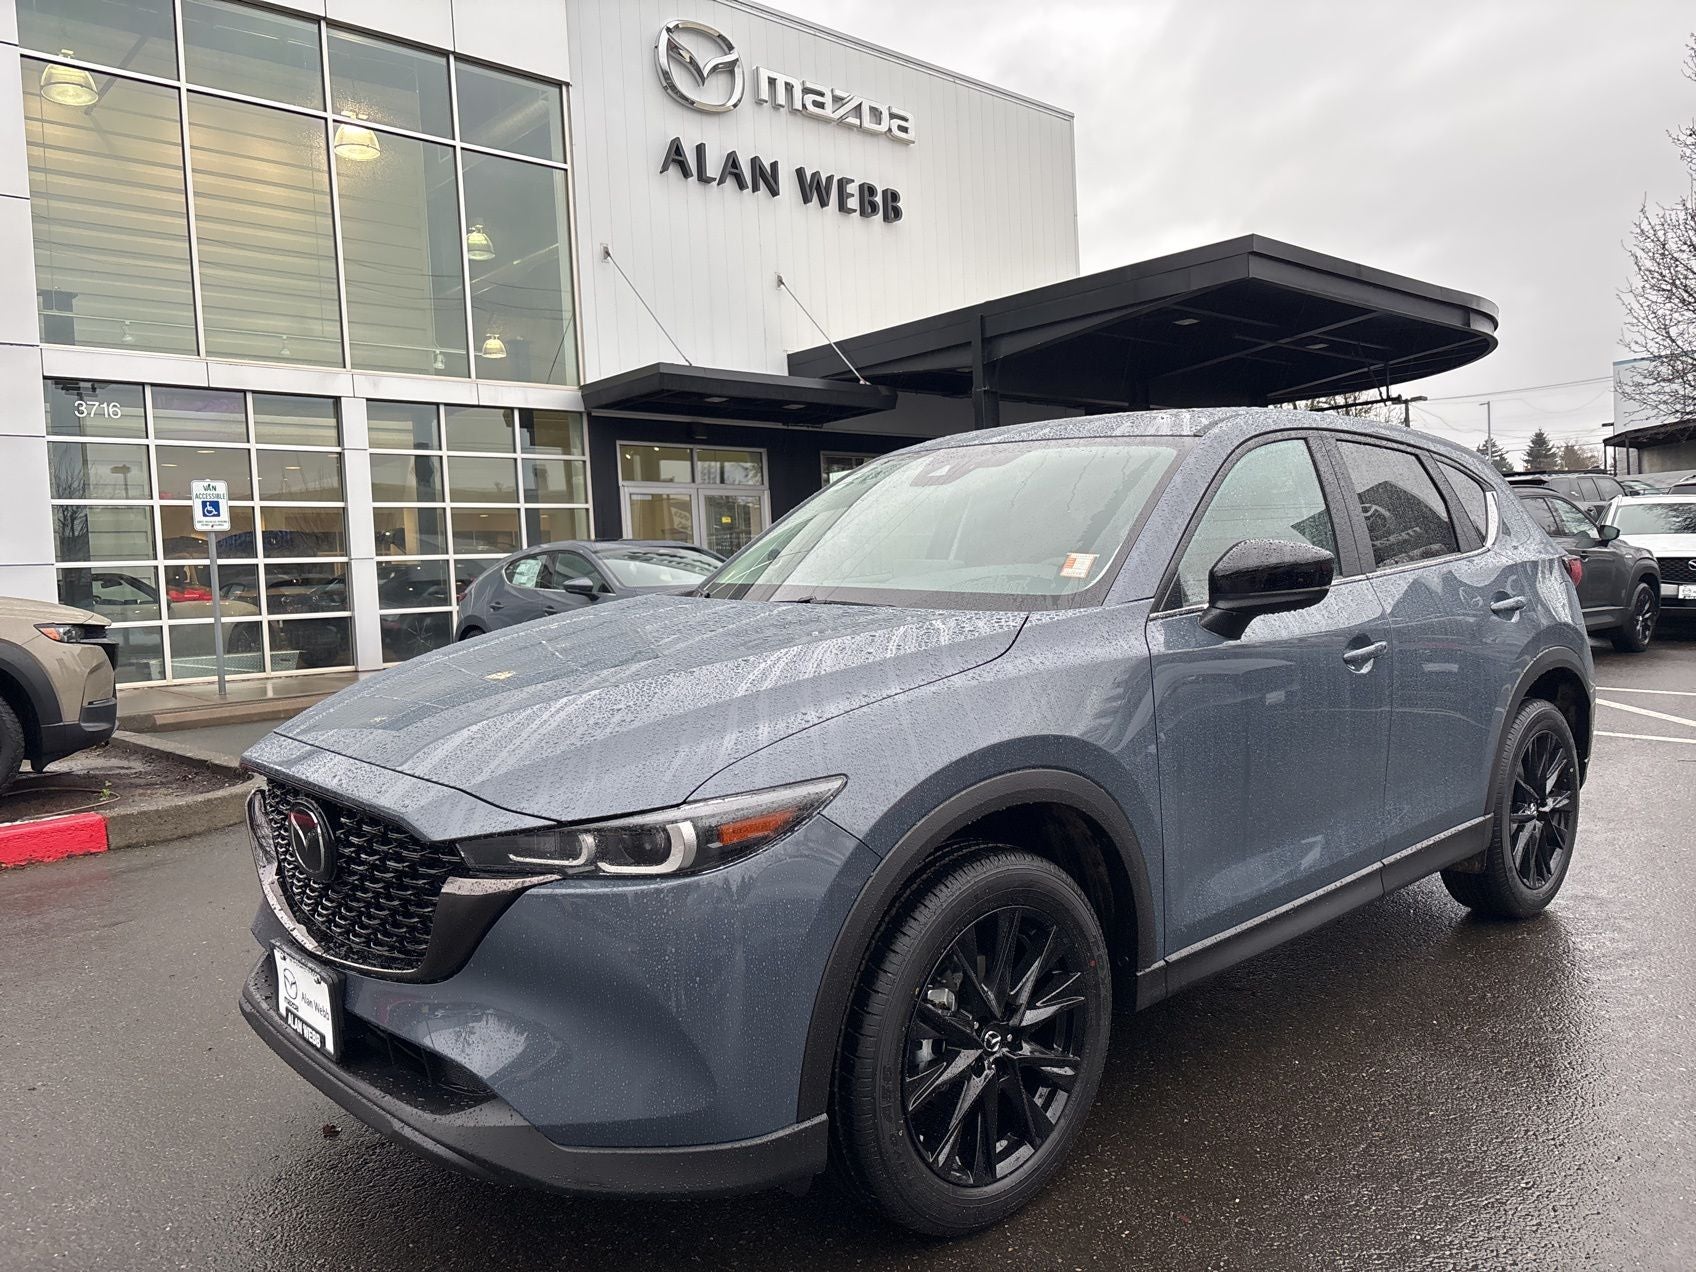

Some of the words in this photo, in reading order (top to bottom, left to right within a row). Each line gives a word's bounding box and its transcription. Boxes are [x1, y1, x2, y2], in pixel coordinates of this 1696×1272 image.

[753, 65, 915, 145] mazda
[659, 136, 780, 198] ALAN
[795, 166, 903, 223] WEBB
[74, 400, 122, 419] 3716
[194, 492, 226, 500] ACCESSIBLE
[202, 483, 217, 491] VAN
[313, 1000, 330, 1021] Webb
[287, 1012, 303, 1035] ALAN
[303, 1022, 321, 1049] WEBB
